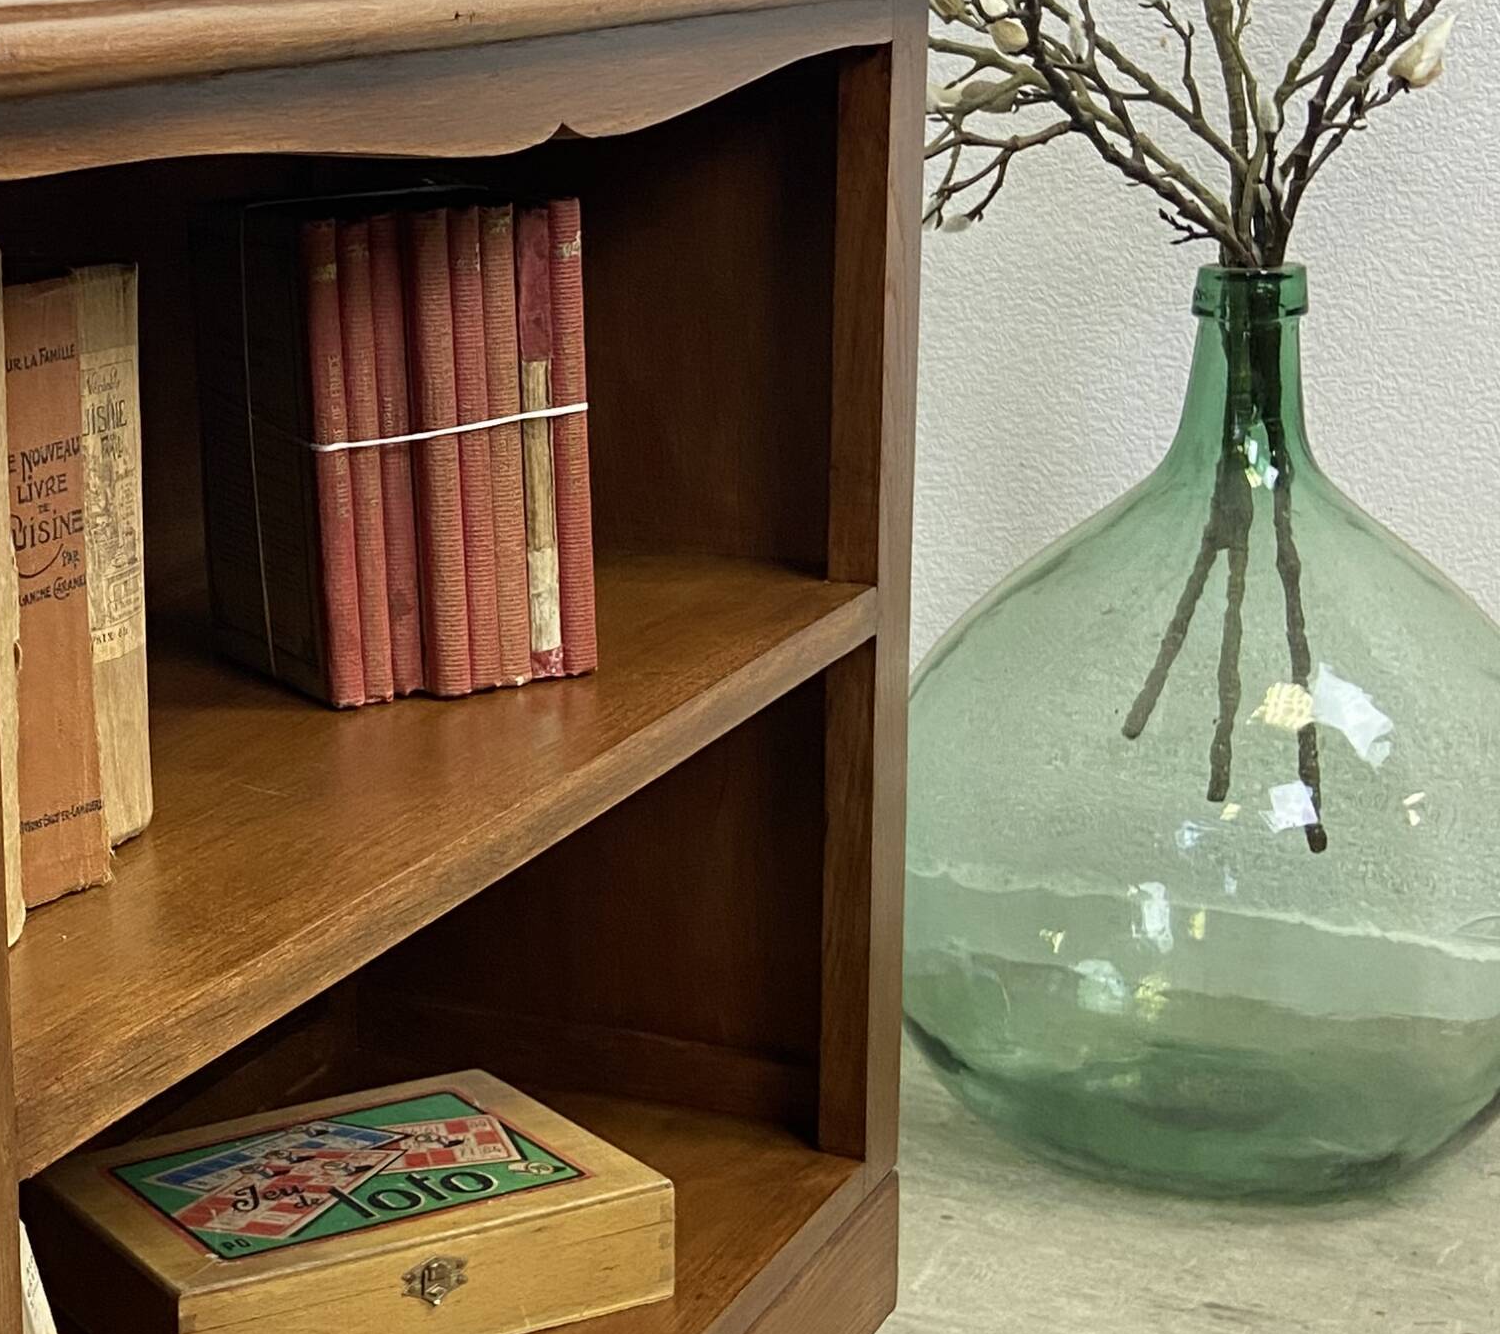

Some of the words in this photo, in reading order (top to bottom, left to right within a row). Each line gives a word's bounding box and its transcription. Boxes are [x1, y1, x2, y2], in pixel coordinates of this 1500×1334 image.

[24, 354, 38, 370] LA
[39, 343, 76, 367] FAMILLE
[20, 435, 81, 483] NOUVEAU
[17, 473, 69, 506] LIVRE
[232, 1184, 304, 1213] Jeu
[293, 1194, 322, 1209] de
[328, 1170, 497, 1218] loto
